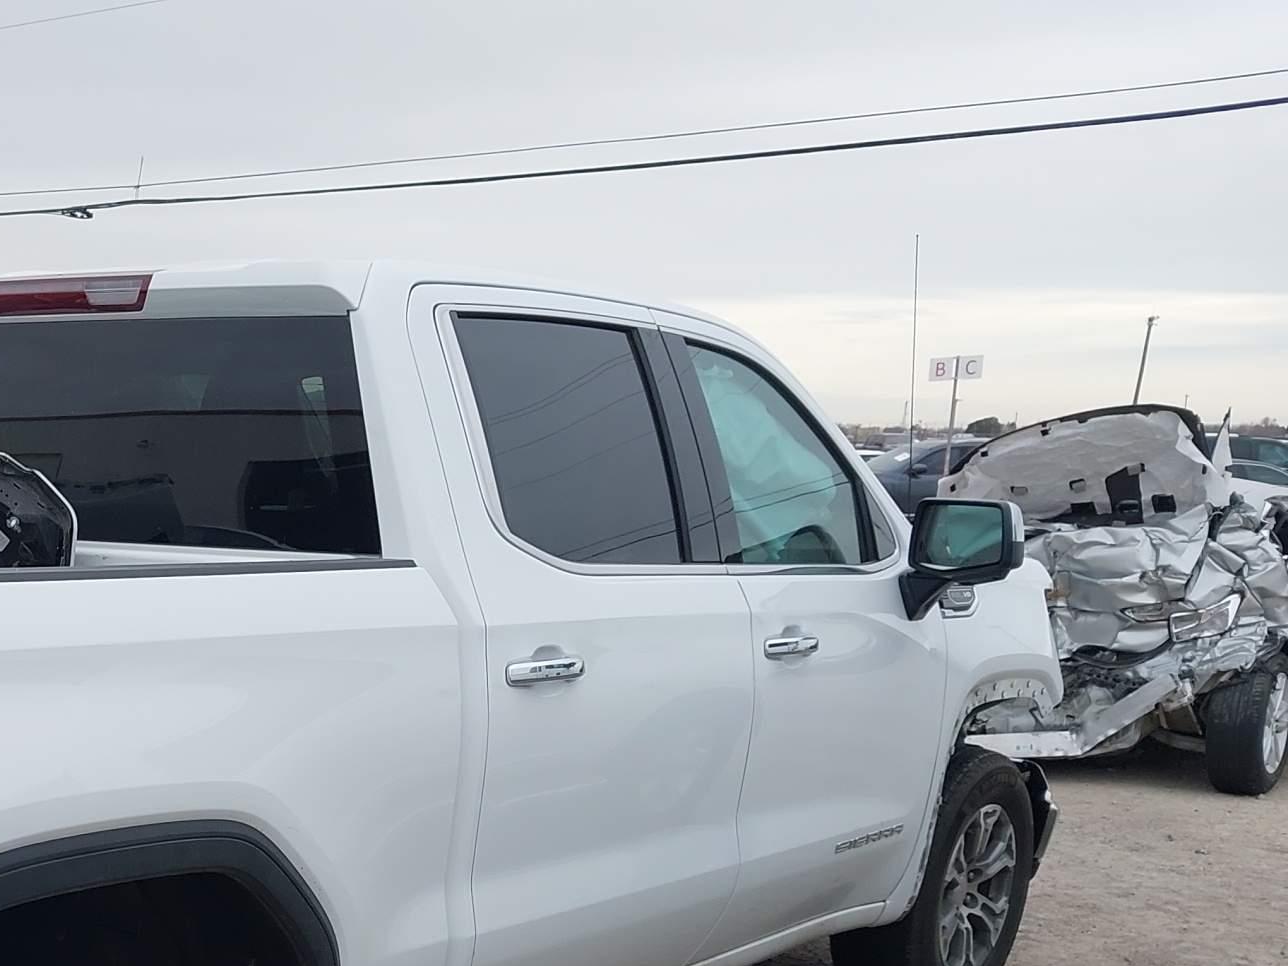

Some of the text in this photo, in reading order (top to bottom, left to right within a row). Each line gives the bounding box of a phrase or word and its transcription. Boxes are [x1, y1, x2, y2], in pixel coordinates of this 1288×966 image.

[935, 360, 977, 377] B C
[834, 823, 904, 854] SIERRA
